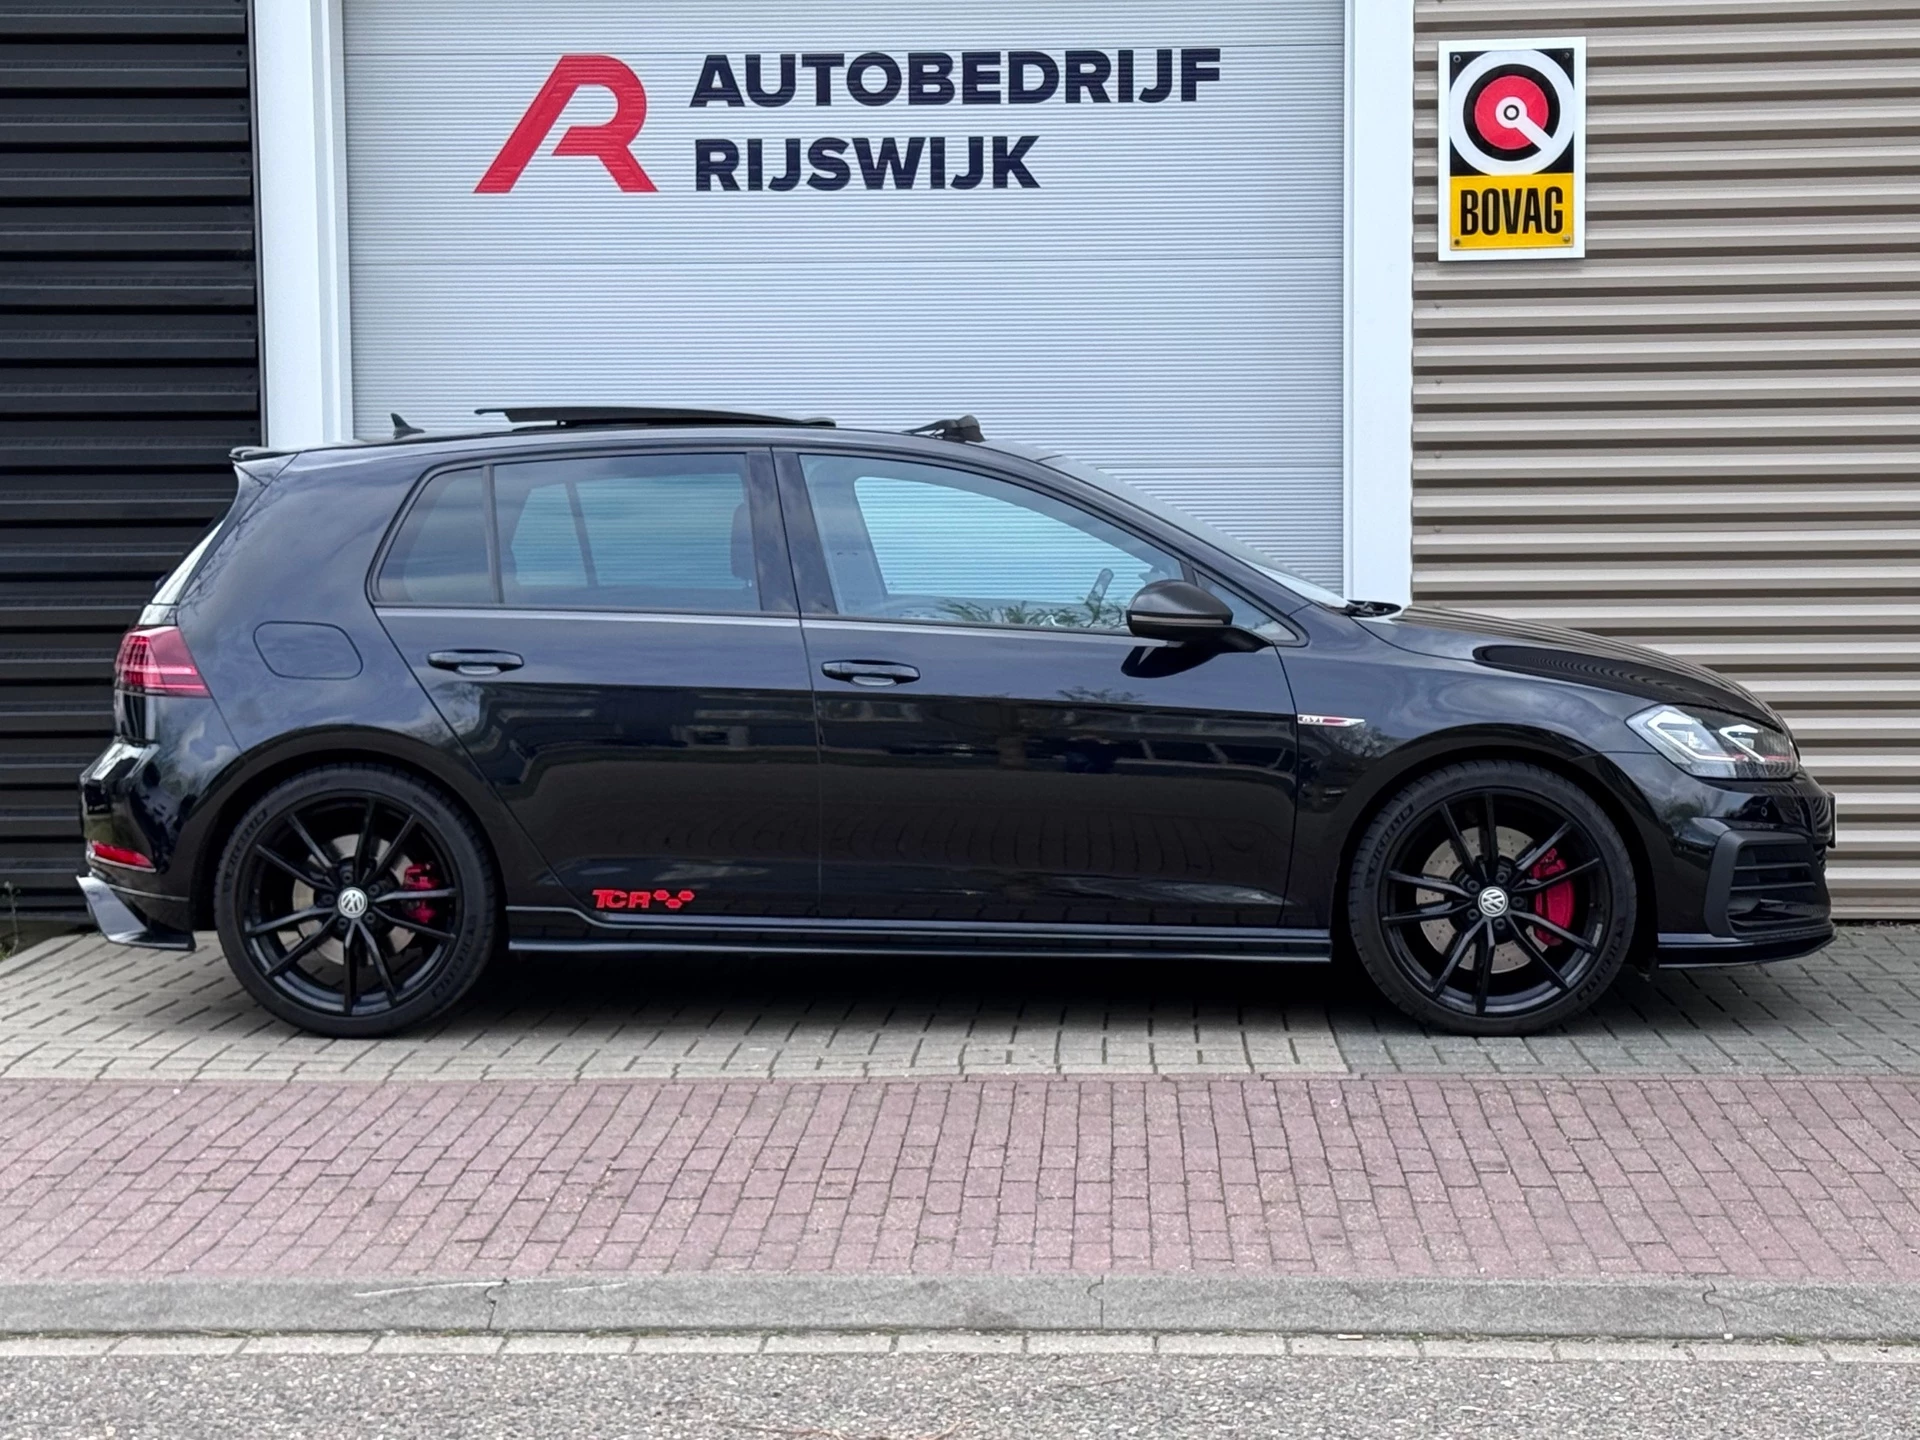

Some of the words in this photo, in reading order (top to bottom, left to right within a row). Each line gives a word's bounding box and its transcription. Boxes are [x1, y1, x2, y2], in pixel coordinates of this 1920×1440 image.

[689, 48, 1221, 108] AUTOBEDRIJF
[695, 135, 1041, 192] RIJSWIJK
[1460, 186, 1564, 236] BOVAG
